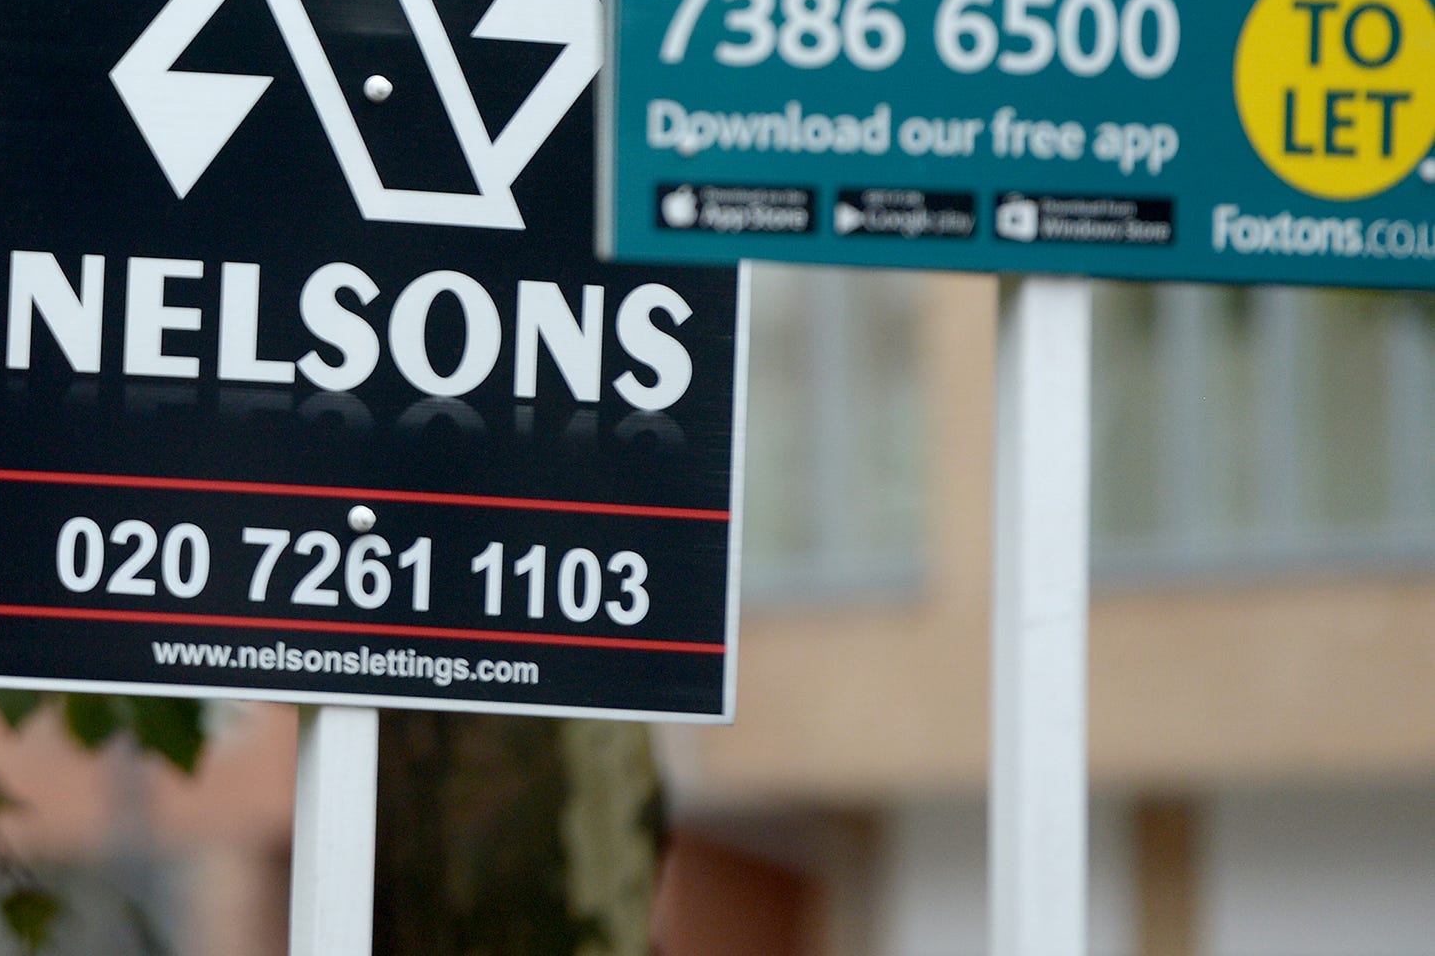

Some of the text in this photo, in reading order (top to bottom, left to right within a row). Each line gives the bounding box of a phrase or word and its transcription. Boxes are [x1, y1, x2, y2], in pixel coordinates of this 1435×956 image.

[1292, 0, 1403, 69] TO
[647, 100, 1179, 176] Download our free app
[1281, 88, 1412, 159] LET
[5, 249, 694, 412] NELSONS
[55, 516, 650, 626] 020 7261 1103
[152, 639, 539, 687] www.nelsonslettings.com
